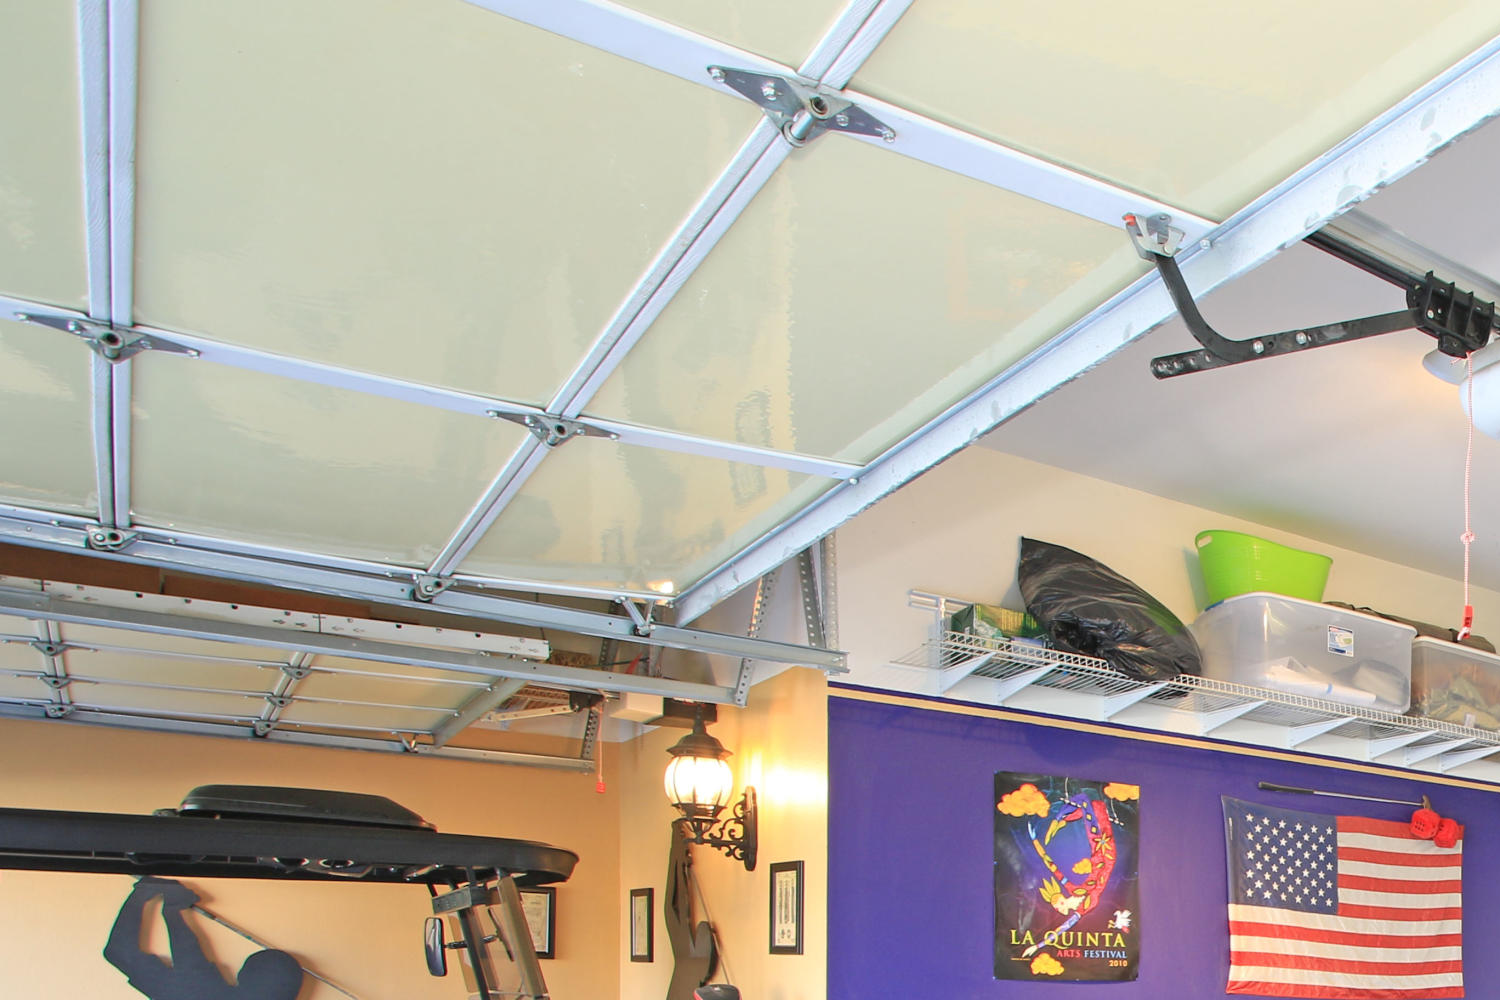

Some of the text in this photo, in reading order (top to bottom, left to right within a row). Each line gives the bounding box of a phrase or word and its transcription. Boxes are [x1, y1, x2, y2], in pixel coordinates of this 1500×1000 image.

[1010, 929, 1127, 949] LA QUINTA
[1056, 949, 1127, 959] ARTS FESTIVAL
